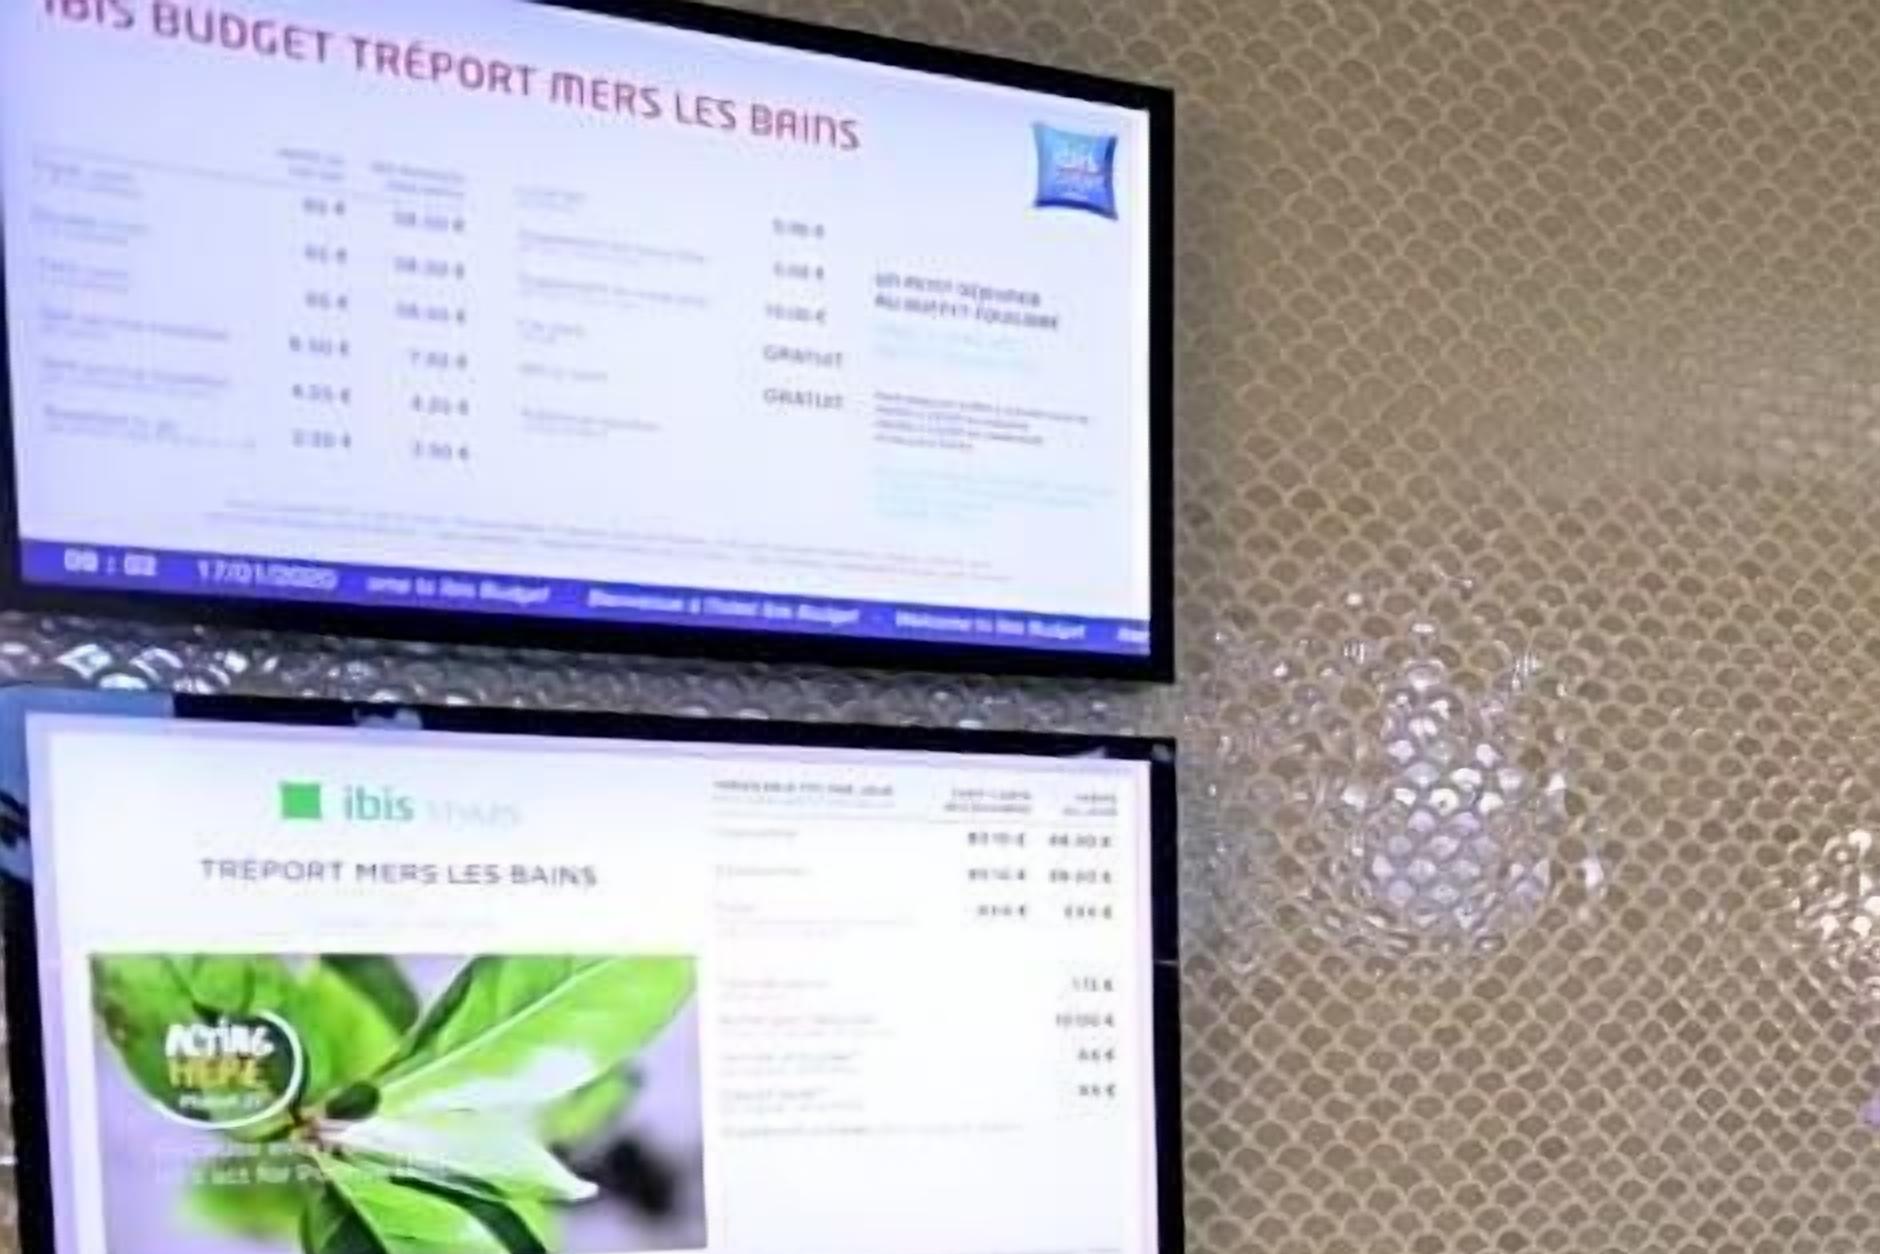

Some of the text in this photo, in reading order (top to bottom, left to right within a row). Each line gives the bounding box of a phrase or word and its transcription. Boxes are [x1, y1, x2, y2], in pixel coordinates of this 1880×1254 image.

[152, 1, 333, 63] BUDGET
[349, 36, 538, 96] TRÉPORT
[550, 71, 662, 119] MERS
[675, 91, 737, 130] LES
[750, 103, 862, 151] BAINS
[762, 343, 845, 370] GRATUIT
[762, 386, 845, 411] GRATUIT
[344, 785, 416, 822] ibis
[354, 862, 438, 884] MERS
[447, 863, 501, 886] LES
[509, 863, 599, 888] BAINS
